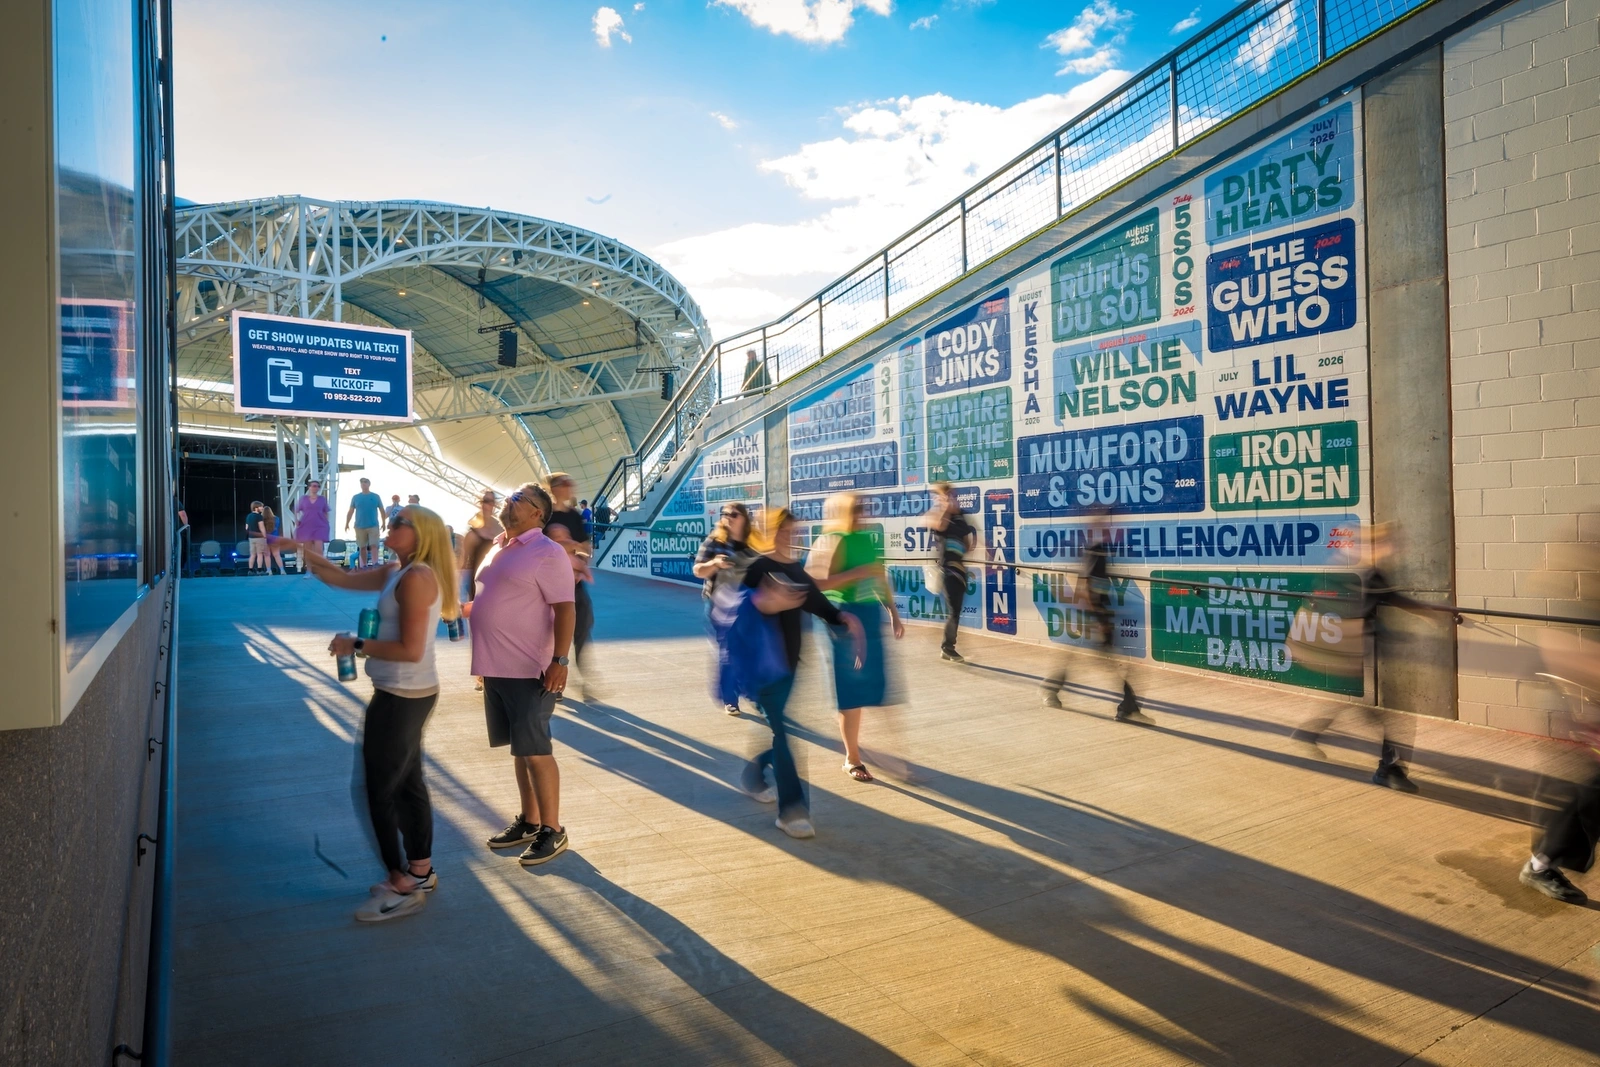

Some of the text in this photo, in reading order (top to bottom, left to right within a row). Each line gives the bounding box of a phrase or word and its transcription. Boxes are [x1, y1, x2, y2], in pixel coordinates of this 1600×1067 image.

[1310, 118, 1334, 134] JULY
[1309, 132, 1335, 146] 2026
[1222, 143, 1334, 205] DIRTY
[1173, 194, 1192, 206] July
[1216, 176, 1342, 236] HEADS
[1125, 224, 1154, 239] AUGUST
[1130, 235, 1149, 246] 2026
[1314, 235, 1342, 249] 2026
[1172, 204, 1194, 306] 5SOS
[1249, 239, 1304, 271] THE
[1212, 256, 1348, 312] GUESS
[1018, 290, 1042, 303] AUGUST
[1058, 286, 1156, 335] DU SOL
[1173, 306, 1194, 317] 2026
[1228, 296, 1330, 342] WHO
[248, 329, 399, 354] GET SHOW UPDATES VIA TEXT!
[938, 318, 997, 358] CODY
[1099, 336, 1125, 349] AUGUST
[935, 349, 1000, 387] JINKS
[1024, 301, 1040, 414] KESHA
[1070, 338, 1181, 385] WILLIE
[1318, 356, 1343, 367] 2026
[1218, 372, 1239, 382] JULY
[1252, 354, 1305, 386] LIL
[331, 378, 374, 390] KICKOFF
[849, 382, 872, 396] THE
[1059, 371, 1197, 420] NELSON
[334, 393, 382, 403] 952-522-2370
[812, 397, 872, 420] DOOBIE
[1214, 378, 1349, 420] WAYNE
[904, 354, 917, 472] SLAYER
[931, 393, 1007, 431] EMPIRE
[1025, 417, 1040, 426] 2026
[794, 416, 872, 445] BROTHERS
[935, 422, 1004, 456] OF THE
[1326, 437, 1352, 448] 2026
[730, 434, 759, 456] JACK
[1030, 427, 1188, 473] MUMFORD
[1216, 448, 1239, 457] SEPT.
[1242, 430, 1321, 468] IRON
[708, 455, 759, 479] JOHNSON
[948, 452, 990, 480] SUN
[994, 459, 1008, 467] 2026
[680, 486, 703, 499] BLACK
[1026, 489, 1040, 497] JULY
[1048, 468, 1164, 507] & SONS
[1175, 478, 1196, 487] 2026
[1218, 465, 1350, 504] MAIDEN
[674, 499, 703, 512] CROWES
[676, 522, 704, 536] GOOD
[1028, 522, 1320, 558] JOHN MELLENCAMP
[1330, 528, 1355, 538] July
[628, 540, 648, 554] CHRIS
[651, 536, 700, 552] CHARLOTT
[1326, 540, 1355, 549] 2026
[612, 555, 648, 568] STAPLETON
[992, 504, 1008, 614] TRAIN
[1032, 574, 1130, 606] HILAY
[1208, 577, 1288, 608] DAVE
[908, 595, 950, 619] CLA
[1166, 606, 1342, 643] MATTHEWS
[1207, 637, 1292, 672] BAND
